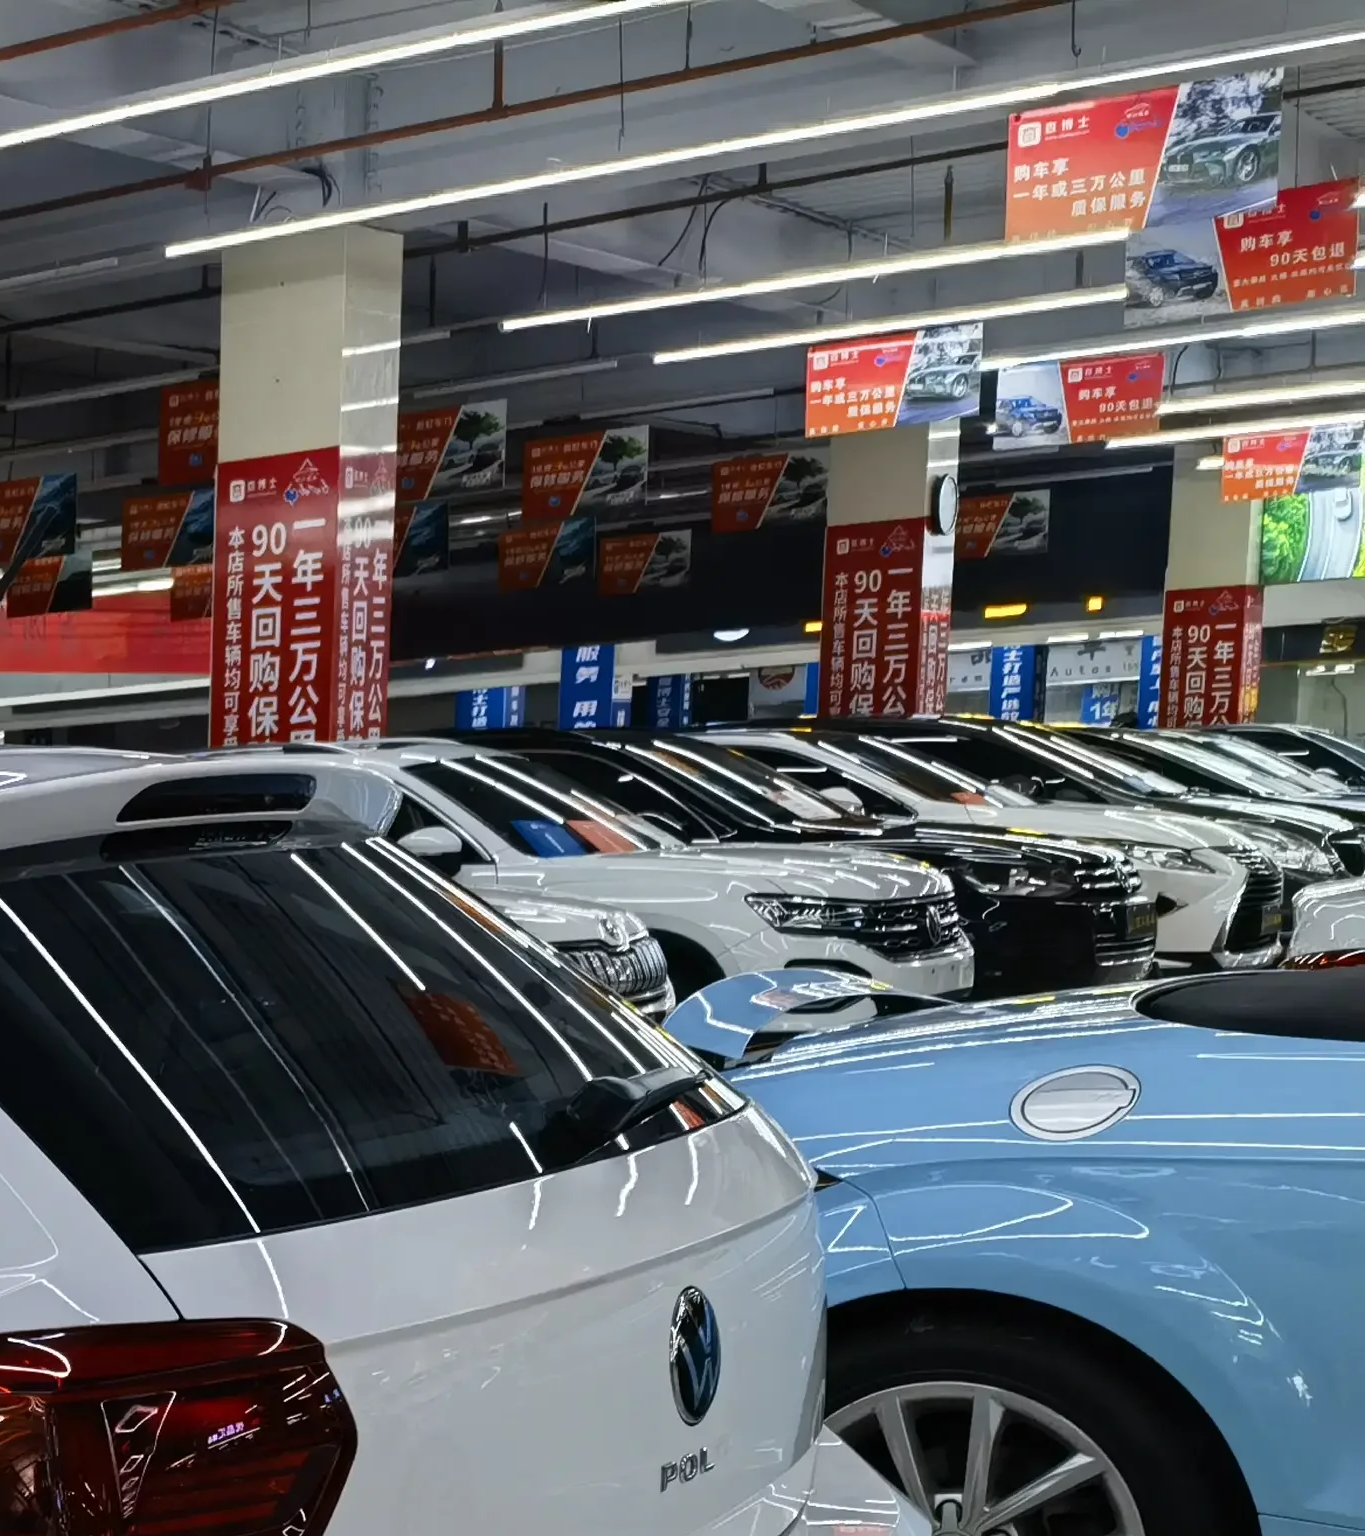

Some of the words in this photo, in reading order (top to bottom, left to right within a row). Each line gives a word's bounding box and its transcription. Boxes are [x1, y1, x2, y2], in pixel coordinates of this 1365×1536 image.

[1014, 158, 1069, 182] 购车享
[1013, 169, 1145, 200] 一年或三万公里
[1071, 191, 1145, 217] 质保服务
[1240, 230, 1293, 252] 购车享
[1270, 242, 1344, 266] 90天包退
[882, 567, 913, 716] 一年三万公
[660, 1447, 716, 1493] POL
